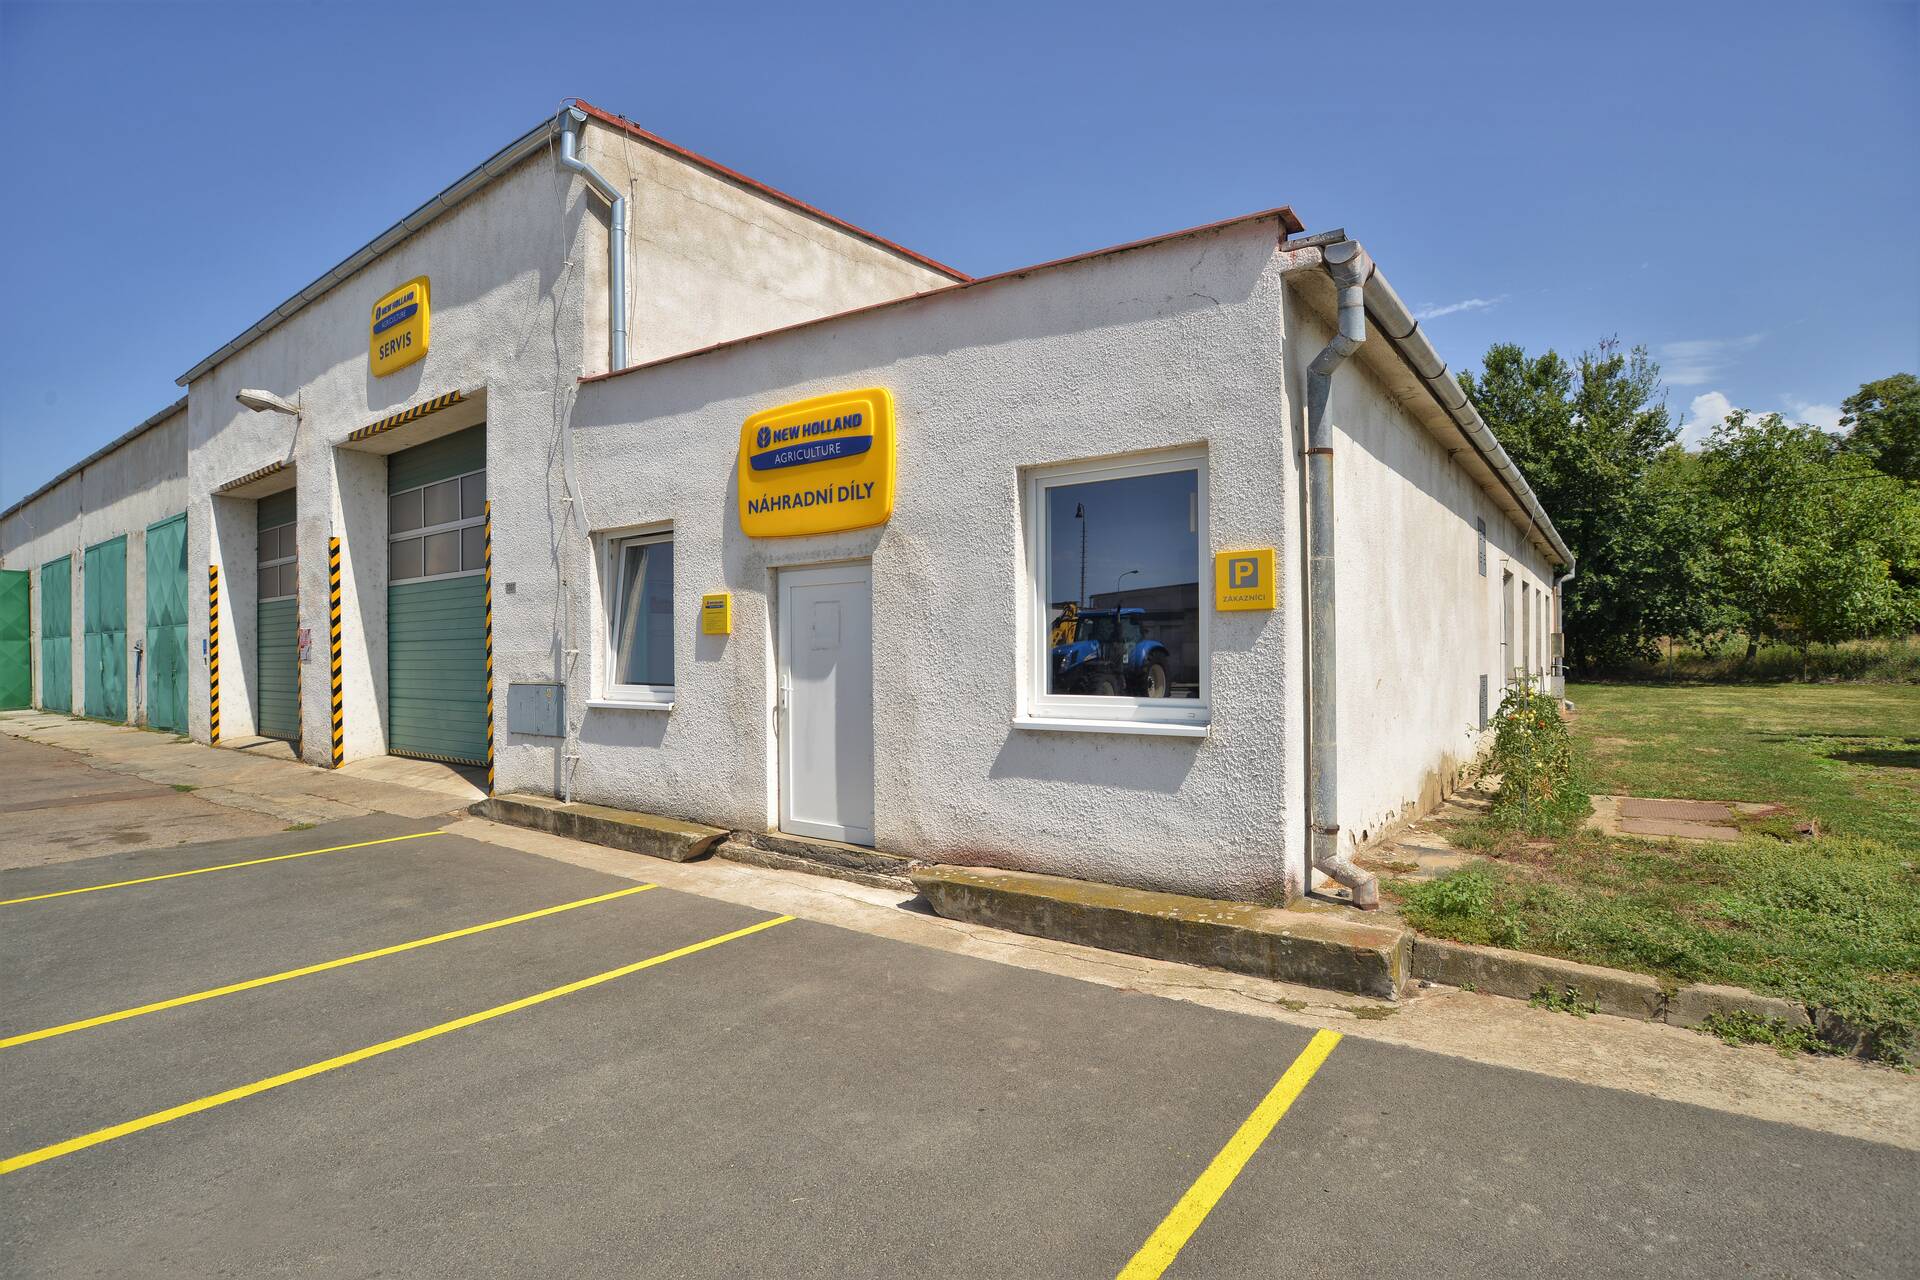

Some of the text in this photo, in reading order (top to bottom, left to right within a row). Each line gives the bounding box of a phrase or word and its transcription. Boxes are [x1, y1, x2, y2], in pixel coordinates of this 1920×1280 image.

[379, 331, 411, 360] SERVIS
[773, 413, 862, 443] NEW HOLLAND
[774, 442, 841, 465] AGRICULTURE
[748, 480, 874, 515] NÁHRADNÍ DÍLY
[1235, 561, 1254, 585] P
